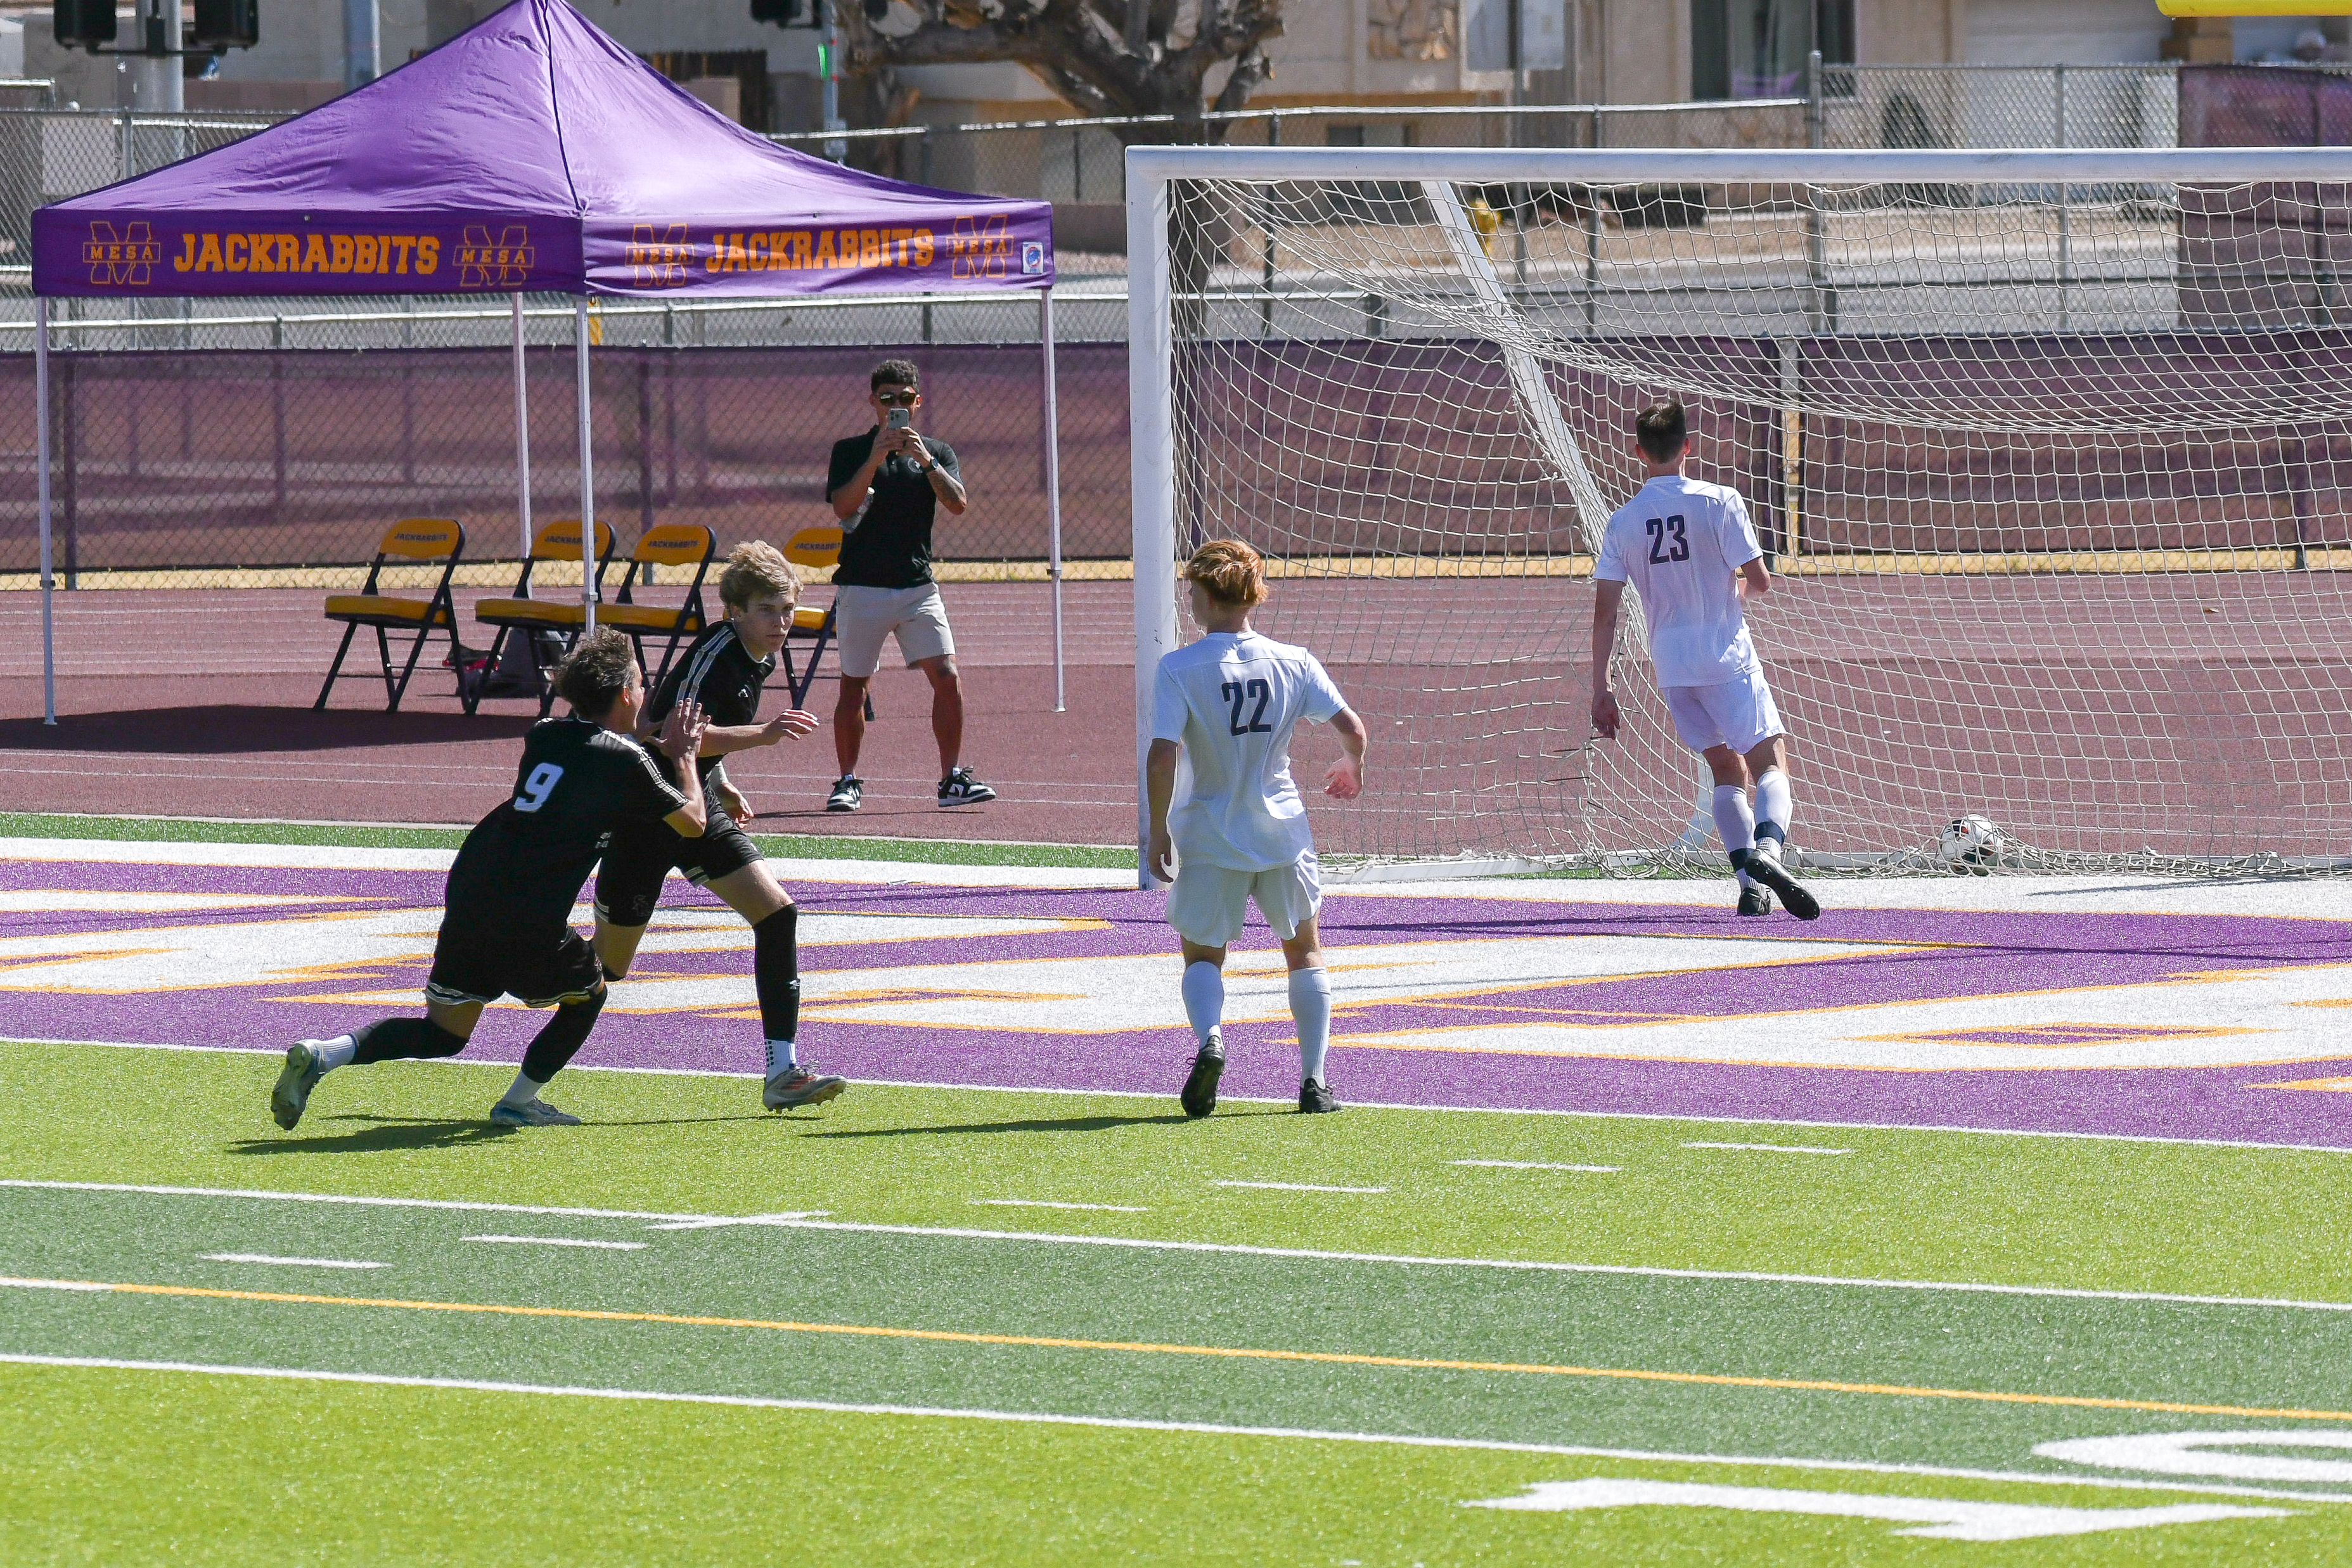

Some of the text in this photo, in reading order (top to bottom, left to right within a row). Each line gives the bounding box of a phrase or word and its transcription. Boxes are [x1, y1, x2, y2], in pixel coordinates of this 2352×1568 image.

[91, 244, 153, 260] MESA
[174, 234, 440, 274] JACKRABBITS
[461, 248, 525, 264] MESA
[632, 247, 688, 263] MESA
[705, 229, 934, 273] JACKRABBITS
[953, 238, 1006, 253] MESA
[1646, 514, 1690, 565] 23
[1221, 678, 1271, 736] 22
[513, 762, 564, 813] 9
